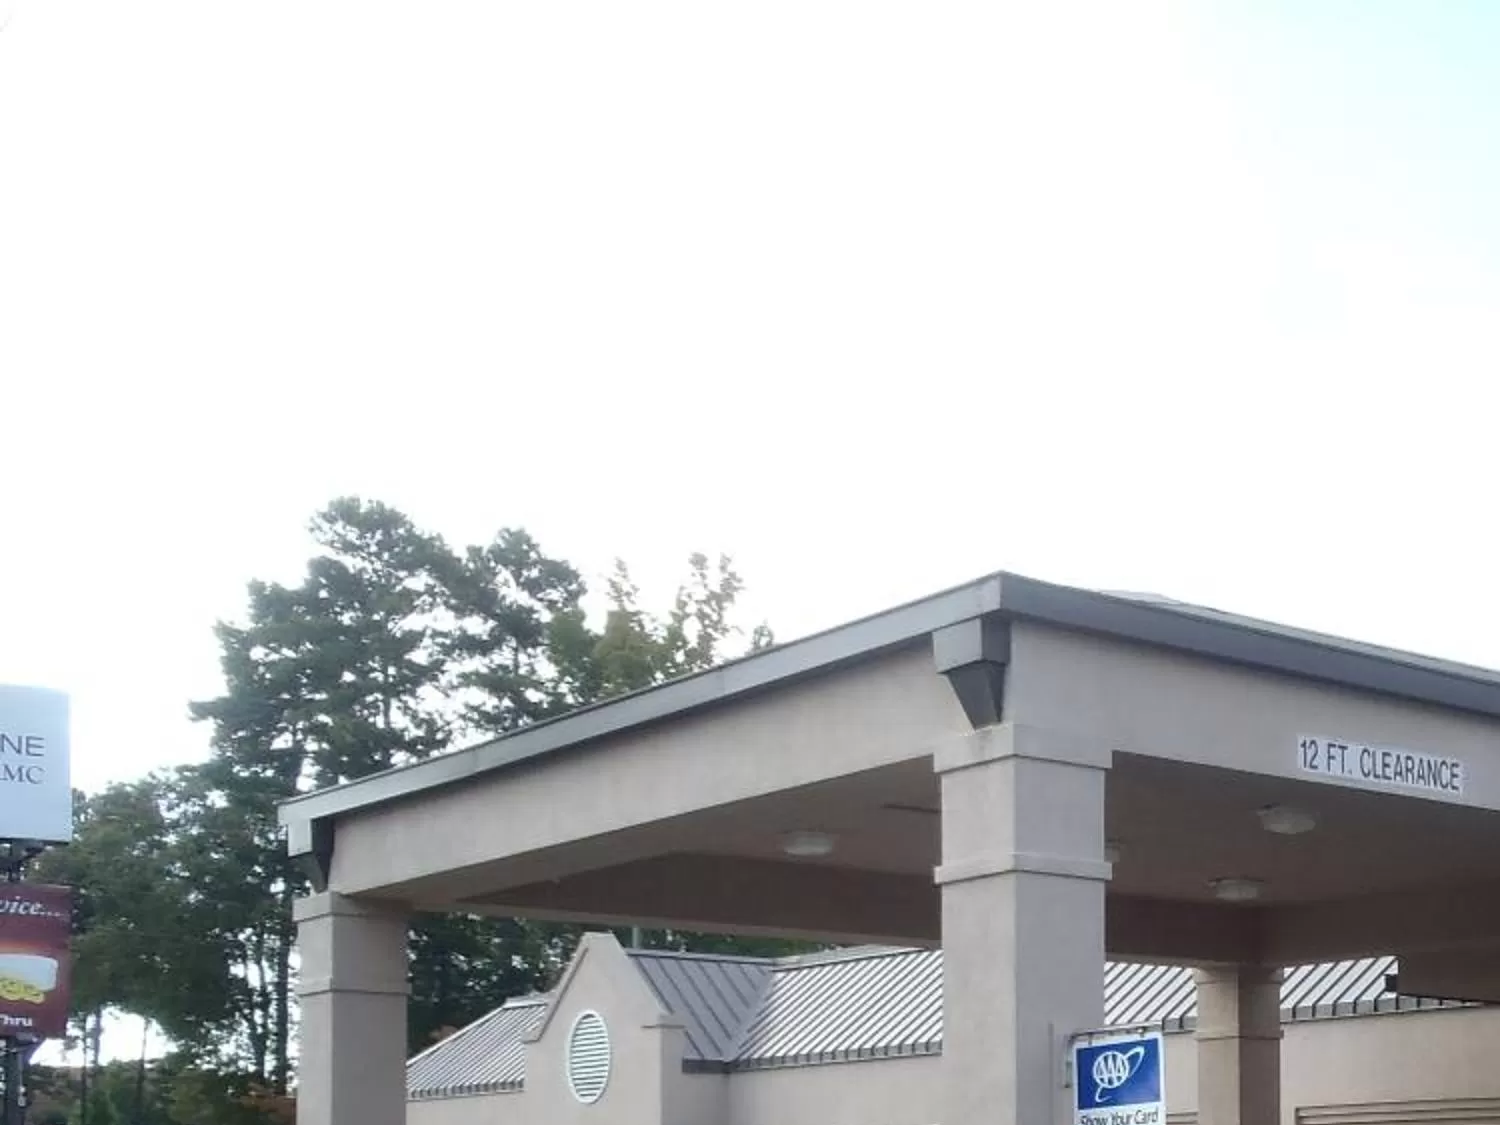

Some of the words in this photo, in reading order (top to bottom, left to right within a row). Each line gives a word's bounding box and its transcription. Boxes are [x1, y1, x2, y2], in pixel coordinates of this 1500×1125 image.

[1299, 738, 1319, 771] 12
[1326, 741, 1353, 775] FT.
[1359, 747, 1460, 791] CLEARANCE
[1094, 1052, 1128, 1088] AAA
[1134, 1105, 1159, 1125] Card
